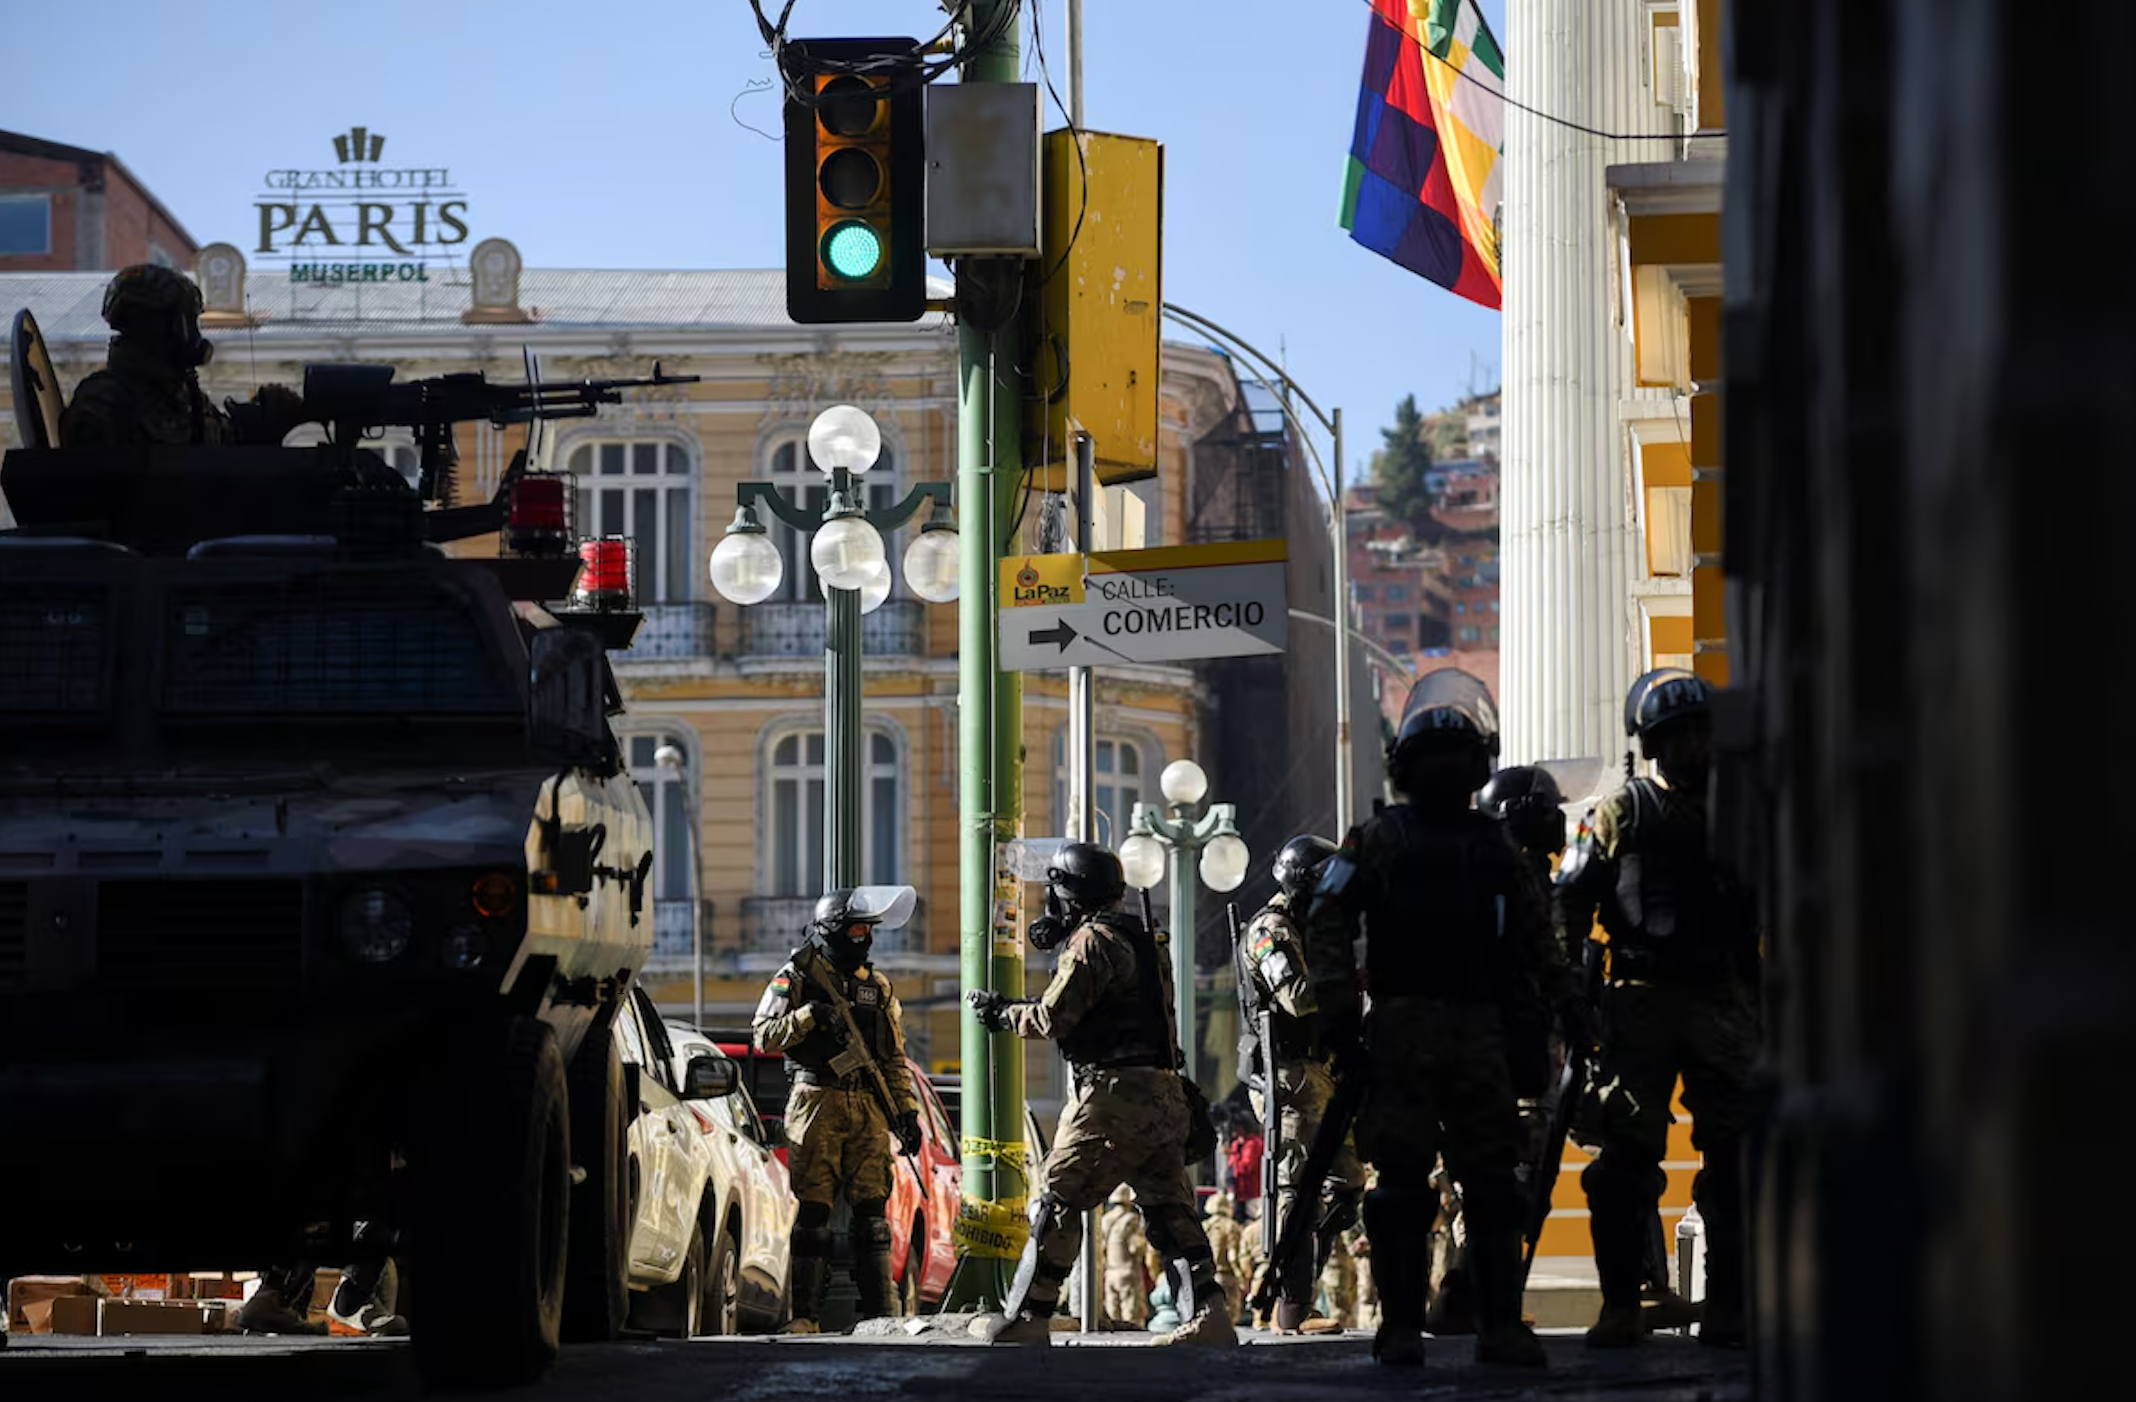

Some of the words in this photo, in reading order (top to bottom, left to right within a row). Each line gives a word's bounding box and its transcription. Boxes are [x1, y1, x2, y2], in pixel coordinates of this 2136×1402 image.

[264, 169, 346, 189] GRAN
[353, 168, 457, 188] HOTEL
[253, 200, 469, 255] PARIS
[290, 262, 429, 283] MUSERPOL
[1101, 578, 1175, 601] CALLE:
[1103, 601, 1265, 636] COMERCIO
